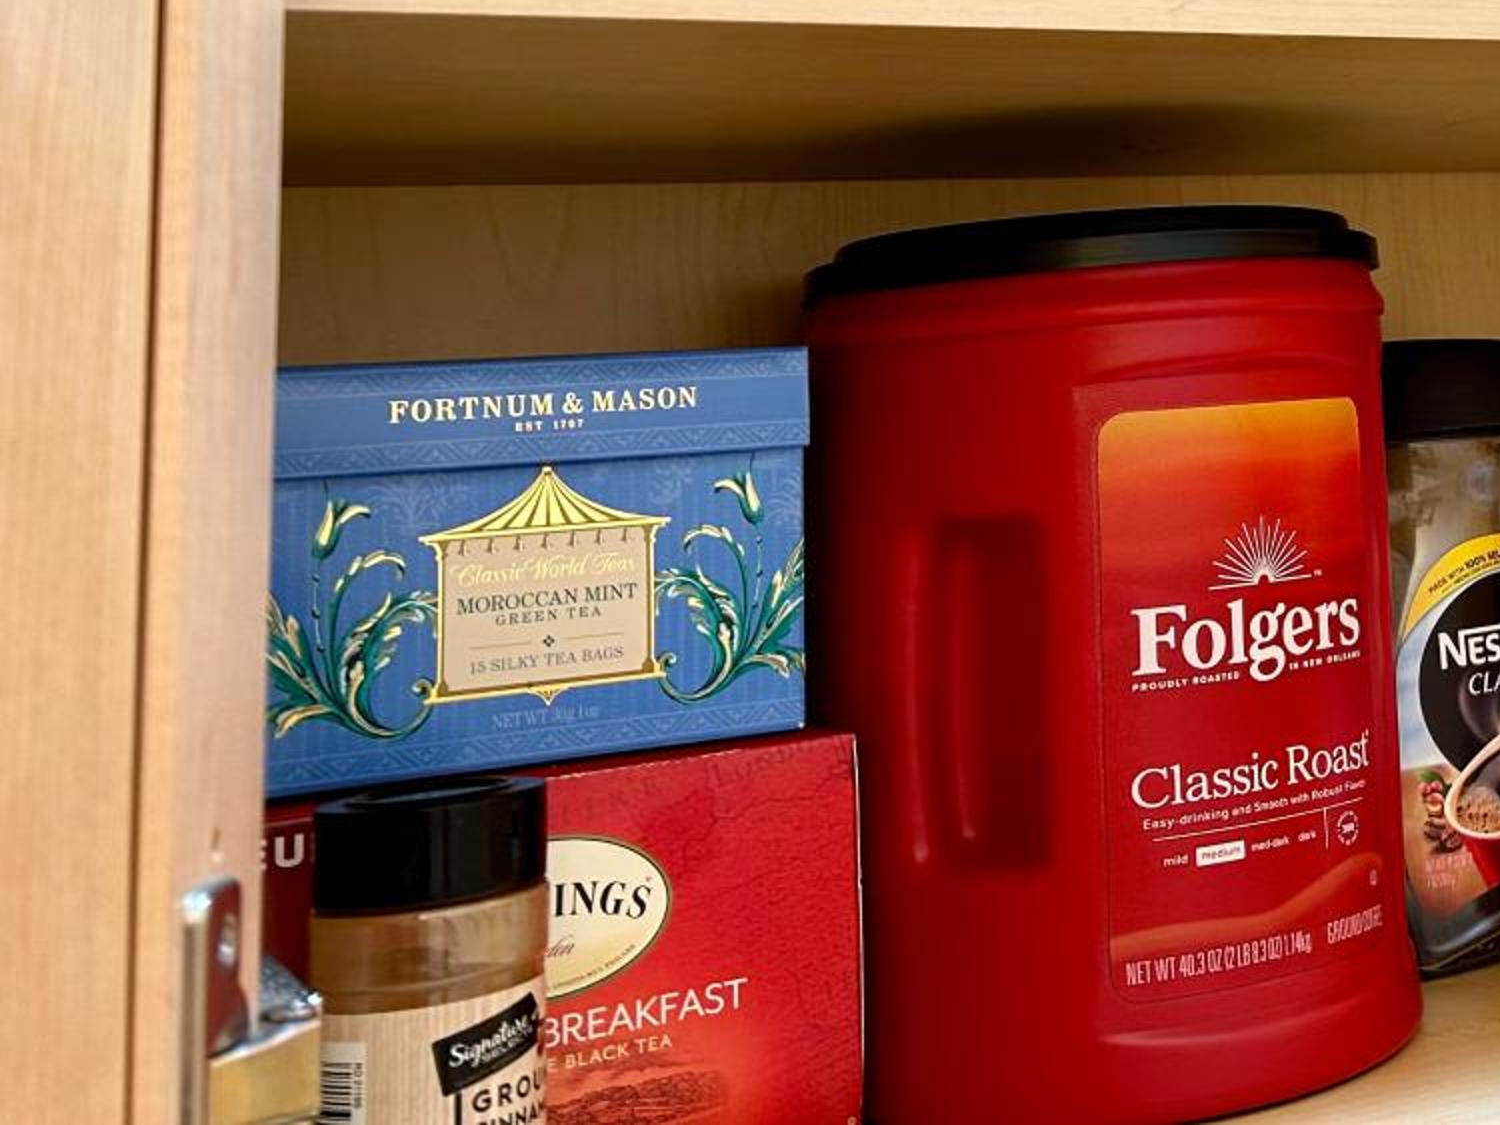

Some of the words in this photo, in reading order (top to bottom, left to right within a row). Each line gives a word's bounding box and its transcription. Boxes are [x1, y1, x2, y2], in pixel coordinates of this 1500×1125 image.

[388, 392, 554, 425] FORTNUM
[561, 391, 584, 415] &
[591, 386, 698, 413] MASON
[450, 563, 525, 588] Classic
[456, 587, 578, 616] MOROCCAN
[584, 582, 638, 603] MINT
[495, 609, 558, 626] GREEN
[566, 606, 602, 620] TEA
[1130, 597, 1361, 682] Folgers
[469, 660, 488, 676] 15
[489, 654, 540, 673] SILKY
[543, 651, 577, 667] TEA
[582, 646, 625, 663] BAGS
[1131, 677, 1189, 693] PROUDLY
[1130, 751, 1280, 810] Classic
[1286, 732, 1370, 786] Roast
[1142, 809, 1230, 831] Easy-drinking
[1231, 804, 1252, 817] and
[1162, 853, 1189, 868] mild
[1200, 844, 1243, 861] medium
[553, 879, 652, 919] INGS
[1125, 960, 1152, 987] NET
[1154, 956, 1176, 982] WT
[1178, 952, 1207, 978] 40.3
[545, 977, 749, 1049] BREAKFAST
[564, 1041, 630, 1070] BLACK
[634, 1033, 673, 1055] TEA
[471, 1069, 544, 1114] GROU
